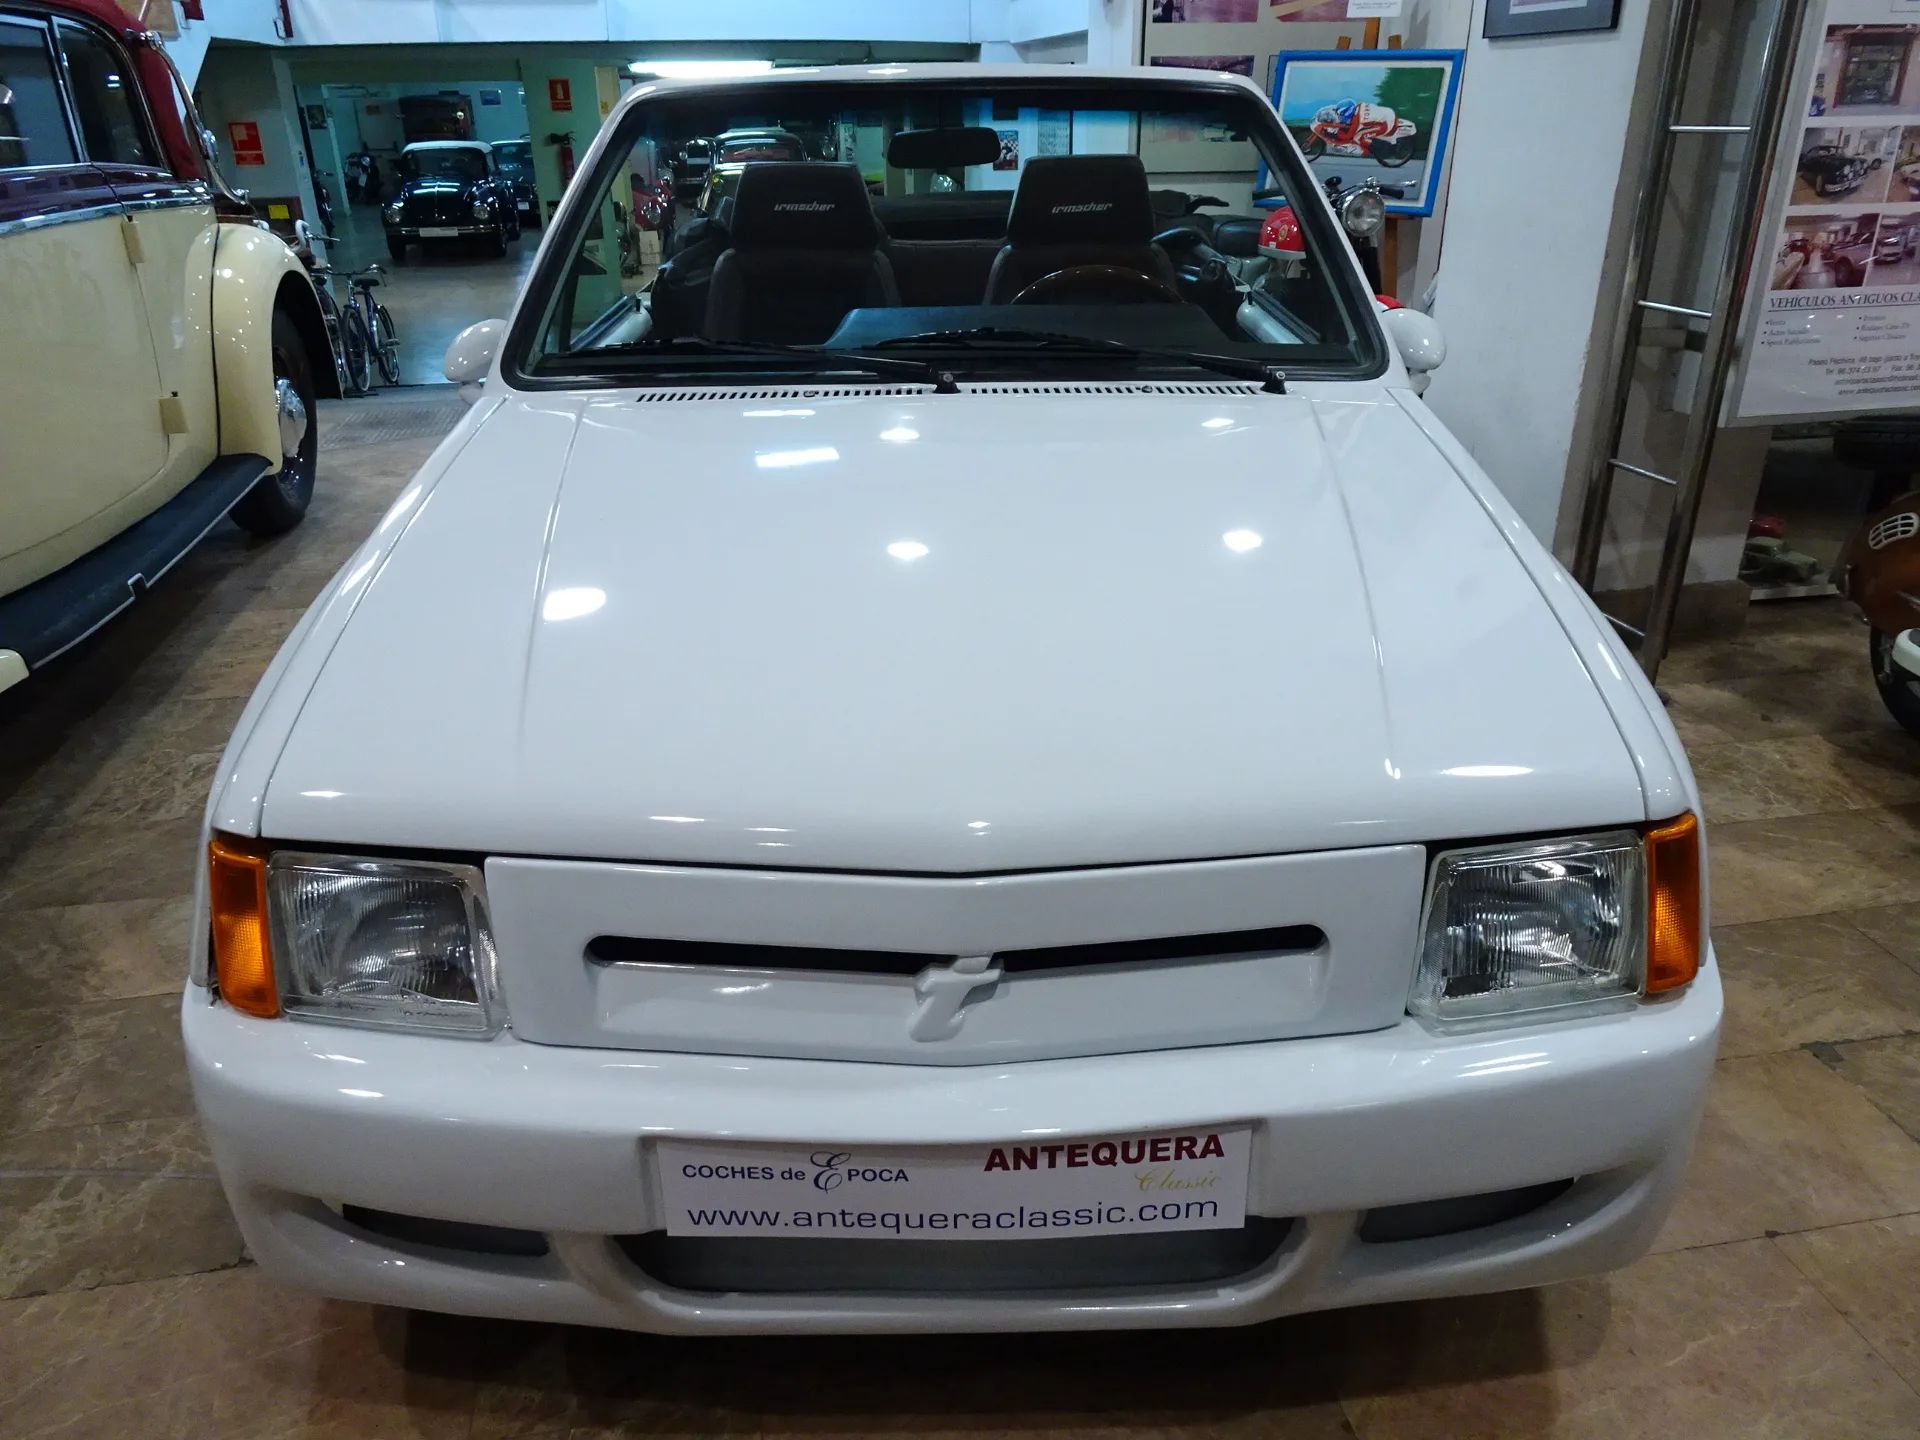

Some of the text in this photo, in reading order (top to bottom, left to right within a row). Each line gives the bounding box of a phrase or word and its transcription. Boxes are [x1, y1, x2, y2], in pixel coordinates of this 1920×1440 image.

[773, 201, 836, 211] irmscher
[1051, 201, 1113, 214] irmscher
[1840, 292, 1898, 305] ANTIGUOS
[983, 1133, 1225, 1172] ANTEQUERA
[682, 1164, 775, 1181] COCHES
[780, 1167, 806, 1181] de
[1135, 1167, 1221, 1192] Classic
[687, 1199, 1218, 1234] www.antequeraclassic.com
